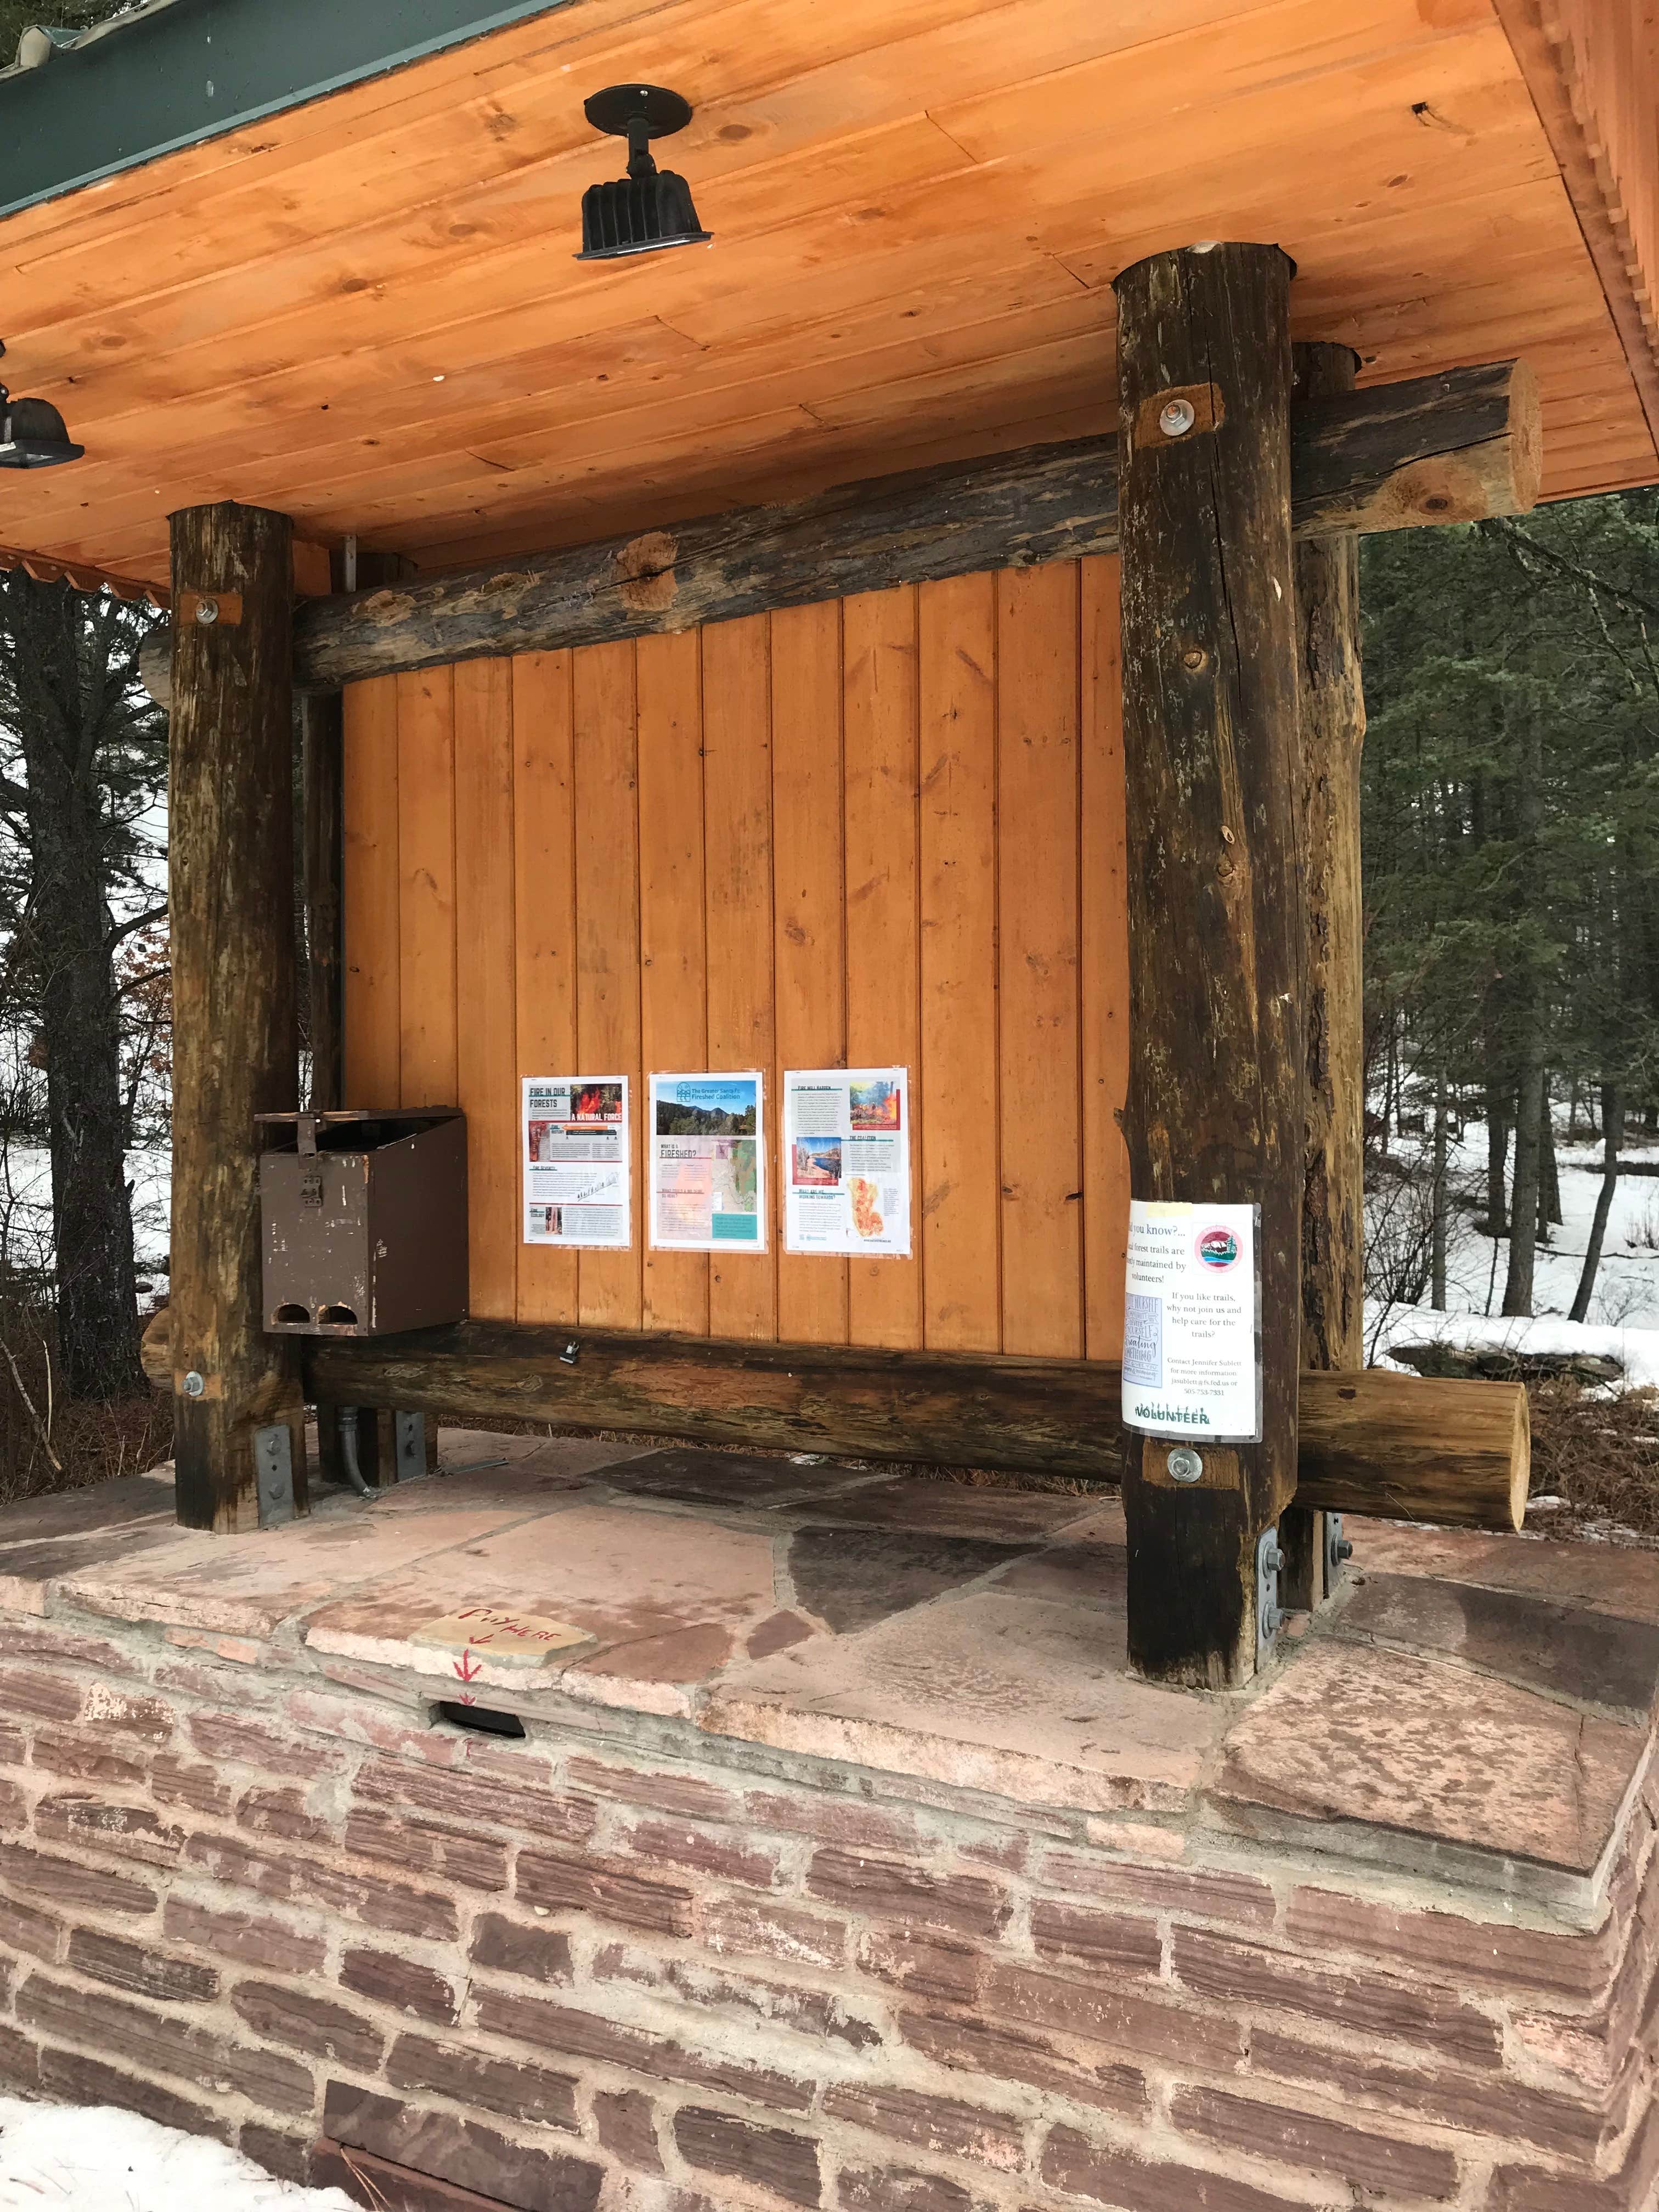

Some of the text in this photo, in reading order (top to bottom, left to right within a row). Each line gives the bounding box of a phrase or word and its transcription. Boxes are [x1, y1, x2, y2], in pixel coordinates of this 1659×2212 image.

[554, 1087, 566, 1096] OUR
[529, 1099, 557, 1108] FORESTS
[604, 1113, 622, 1121] FORCE
[661, 1149, 696, 1159] FIRESHED?
[1133, 1224, 1144, 1237] you
[1146, 1224, 1186, 1236] know?...
[1134, 1243, 1148, 1252] forest
[1150, 1245, 1169, 1254] trails
[1136, 1259, 1173, 1269] maintained
[1176, 1261, 1187, 1273] by
[1132, 1272, 1164, 1283] volunteers!
[1166, 1304, 1181, 1314] why
[1198, 1306, 1214, 1314] join
[1172, 1316, 1188, 1327] help
[1135, 1403, 1210, 1424] VOLUNTEER
[499, 1624, 562, 1640] HERE
